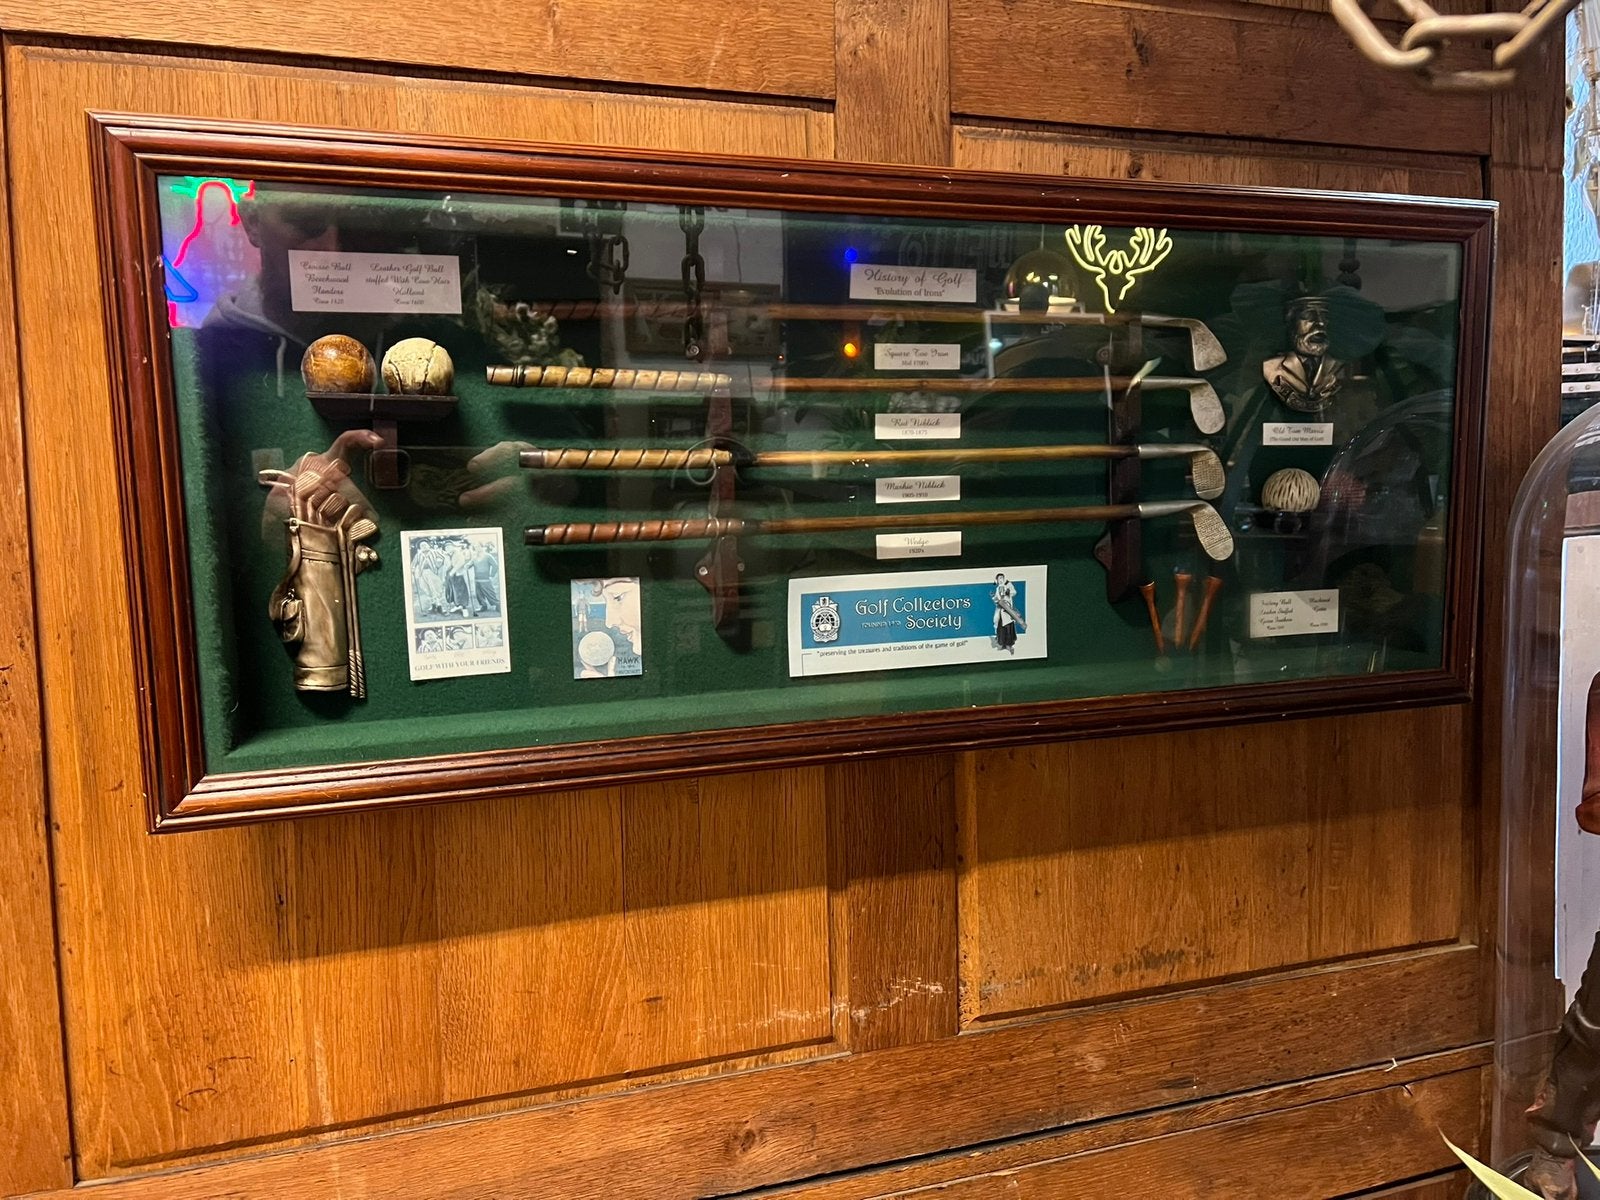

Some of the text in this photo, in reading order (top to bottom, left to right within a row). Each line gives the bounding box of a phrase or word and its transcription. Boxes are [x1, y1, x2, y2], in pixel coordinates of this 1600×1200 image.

[331, 262, 352, 271] Ball
[370, 263, 444, 274] Leather Golf Ball
[864, 268, 962, 288] History of Golf
[914, 288, 922, 296] of
[904, 537, 930, 548] Wedge
[855, 597, 972, 618] Golf Collectors
[905, 614, 962, 630] Society
[455, 660, 475, 668] YOUR
[476, 658, 505, 666] FRIENDS
